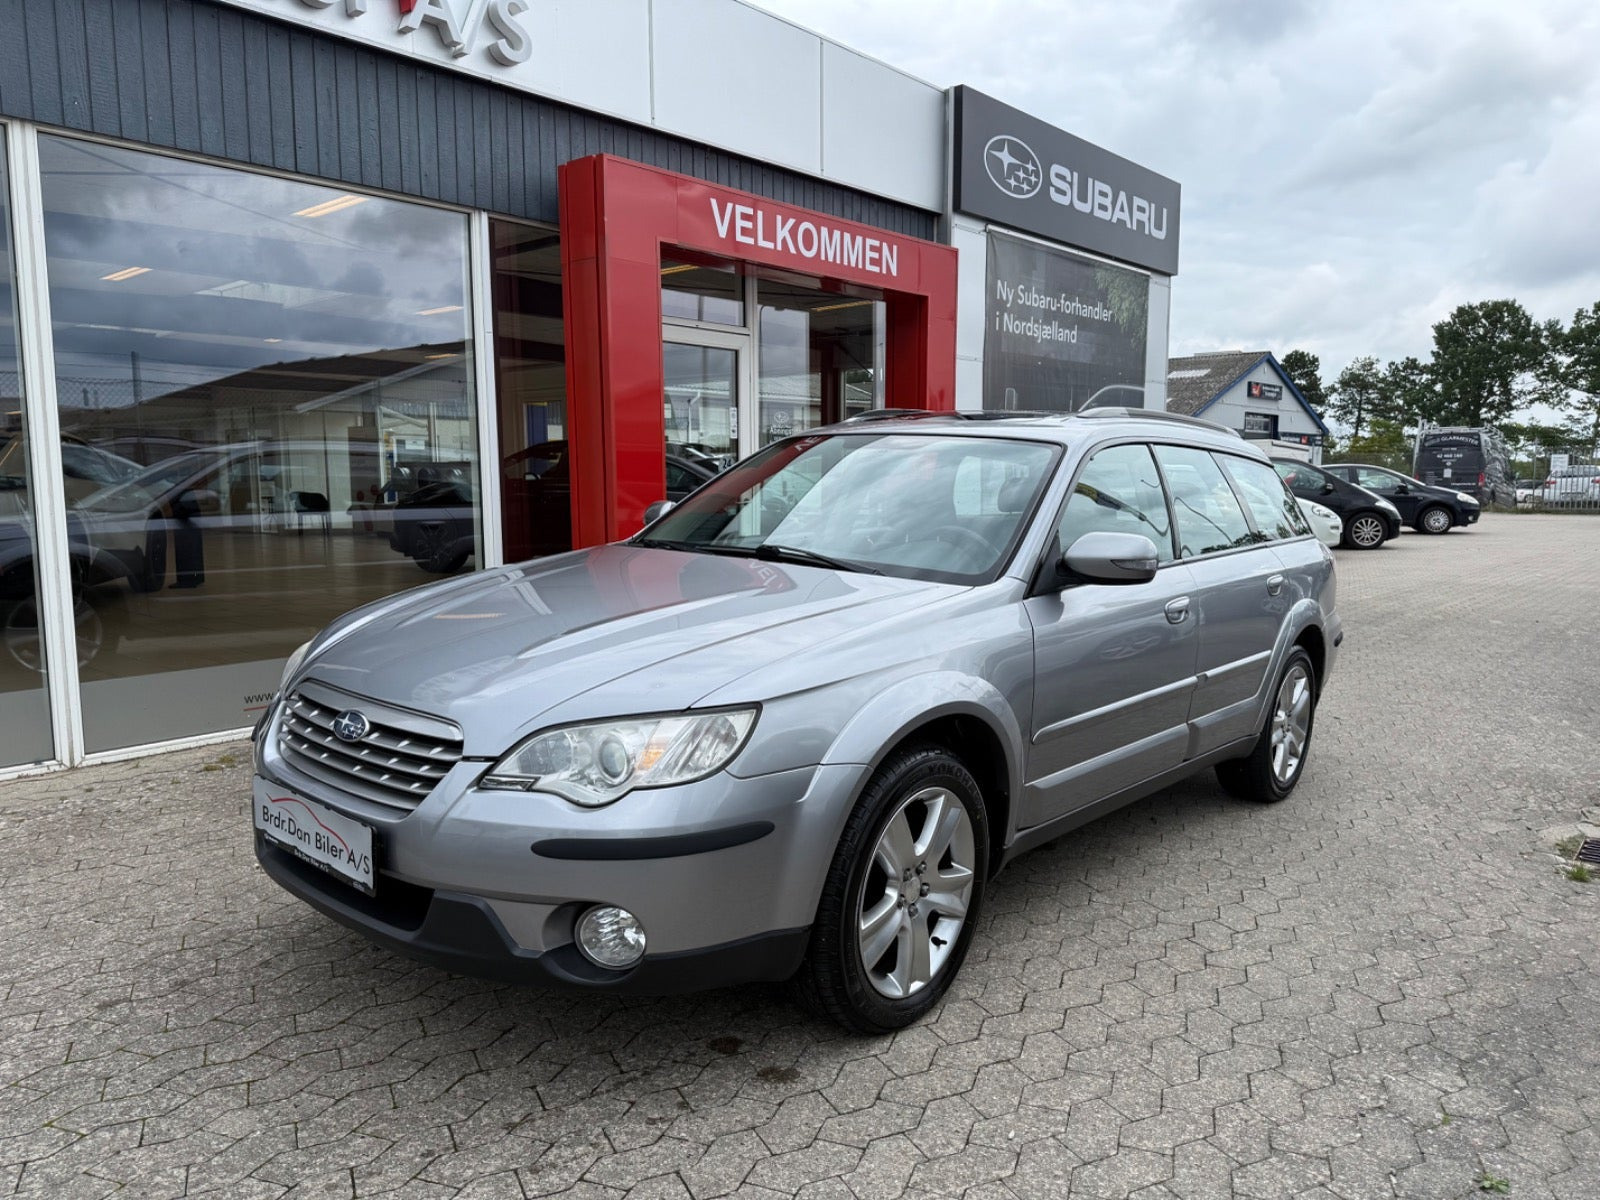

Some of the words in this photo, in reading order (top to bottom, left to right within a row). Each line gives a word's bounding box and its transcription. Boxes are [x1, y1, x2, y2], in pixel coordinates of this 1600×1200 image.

[398, 0, 533, 66] A/S
[1049, 163, 1167, 240] SUBARU
[710, 197, 898, 277] VELKOMMEN
[995, 311, 1000, 331] i
[1003, 312, 1078, 343] Nordsjælland
[996, 279, 1014, 307] Ny
[1017, 285, 1114, 322] Subaru-forhandler
[262, 804, 311, 846] Brdr.Dan
[315, 832, 345, 861] Biler
[347, 848, 371, 875] A/S
